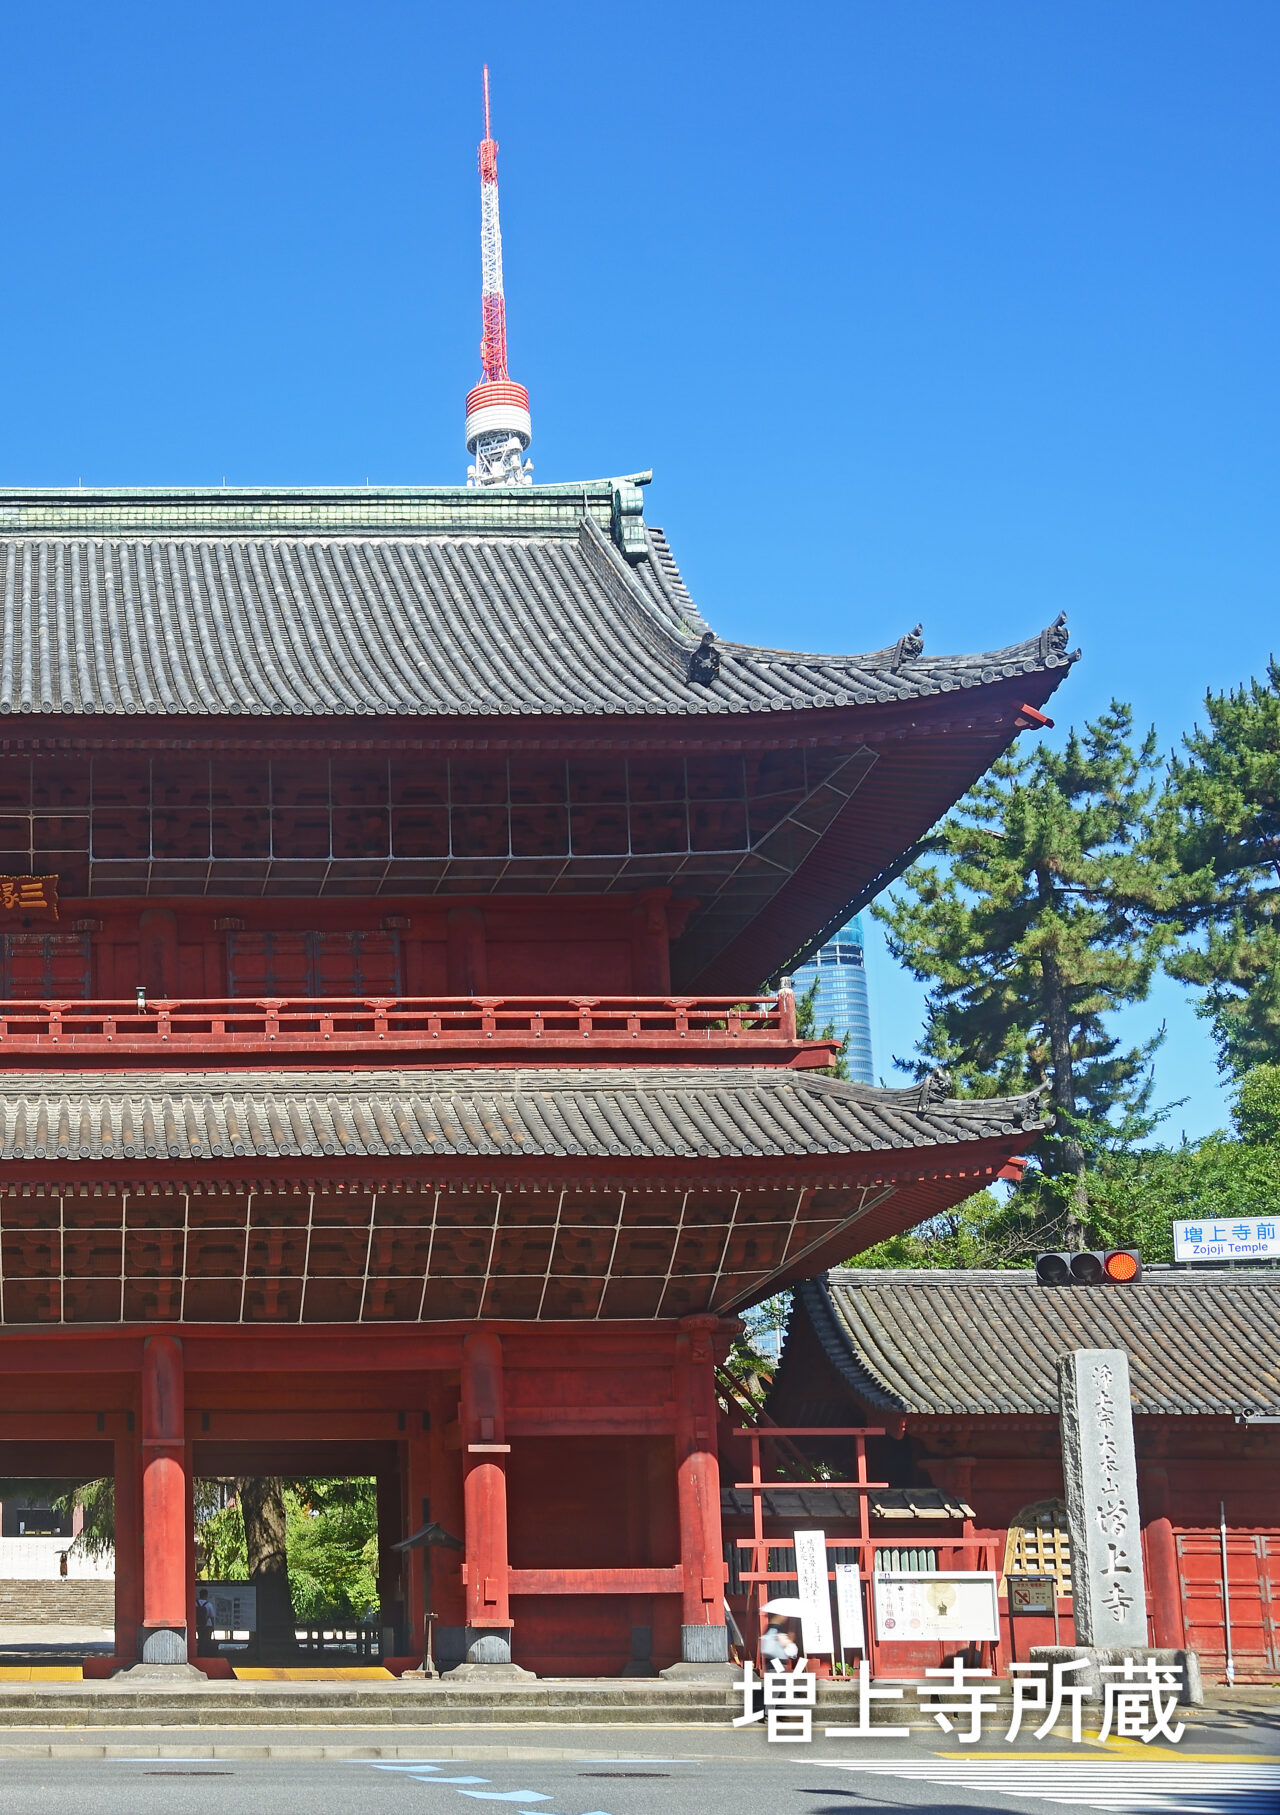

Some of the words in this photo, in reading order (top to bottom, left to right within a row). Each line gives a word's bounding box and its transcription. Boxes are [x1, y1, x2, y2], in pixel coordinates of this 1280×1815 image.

[1183, 1222, 1275, 1243] 増上寺前
[1193, 1243, 1224, 1255] Zojoji
[1228, 1242, 1268, 1253] Temple
